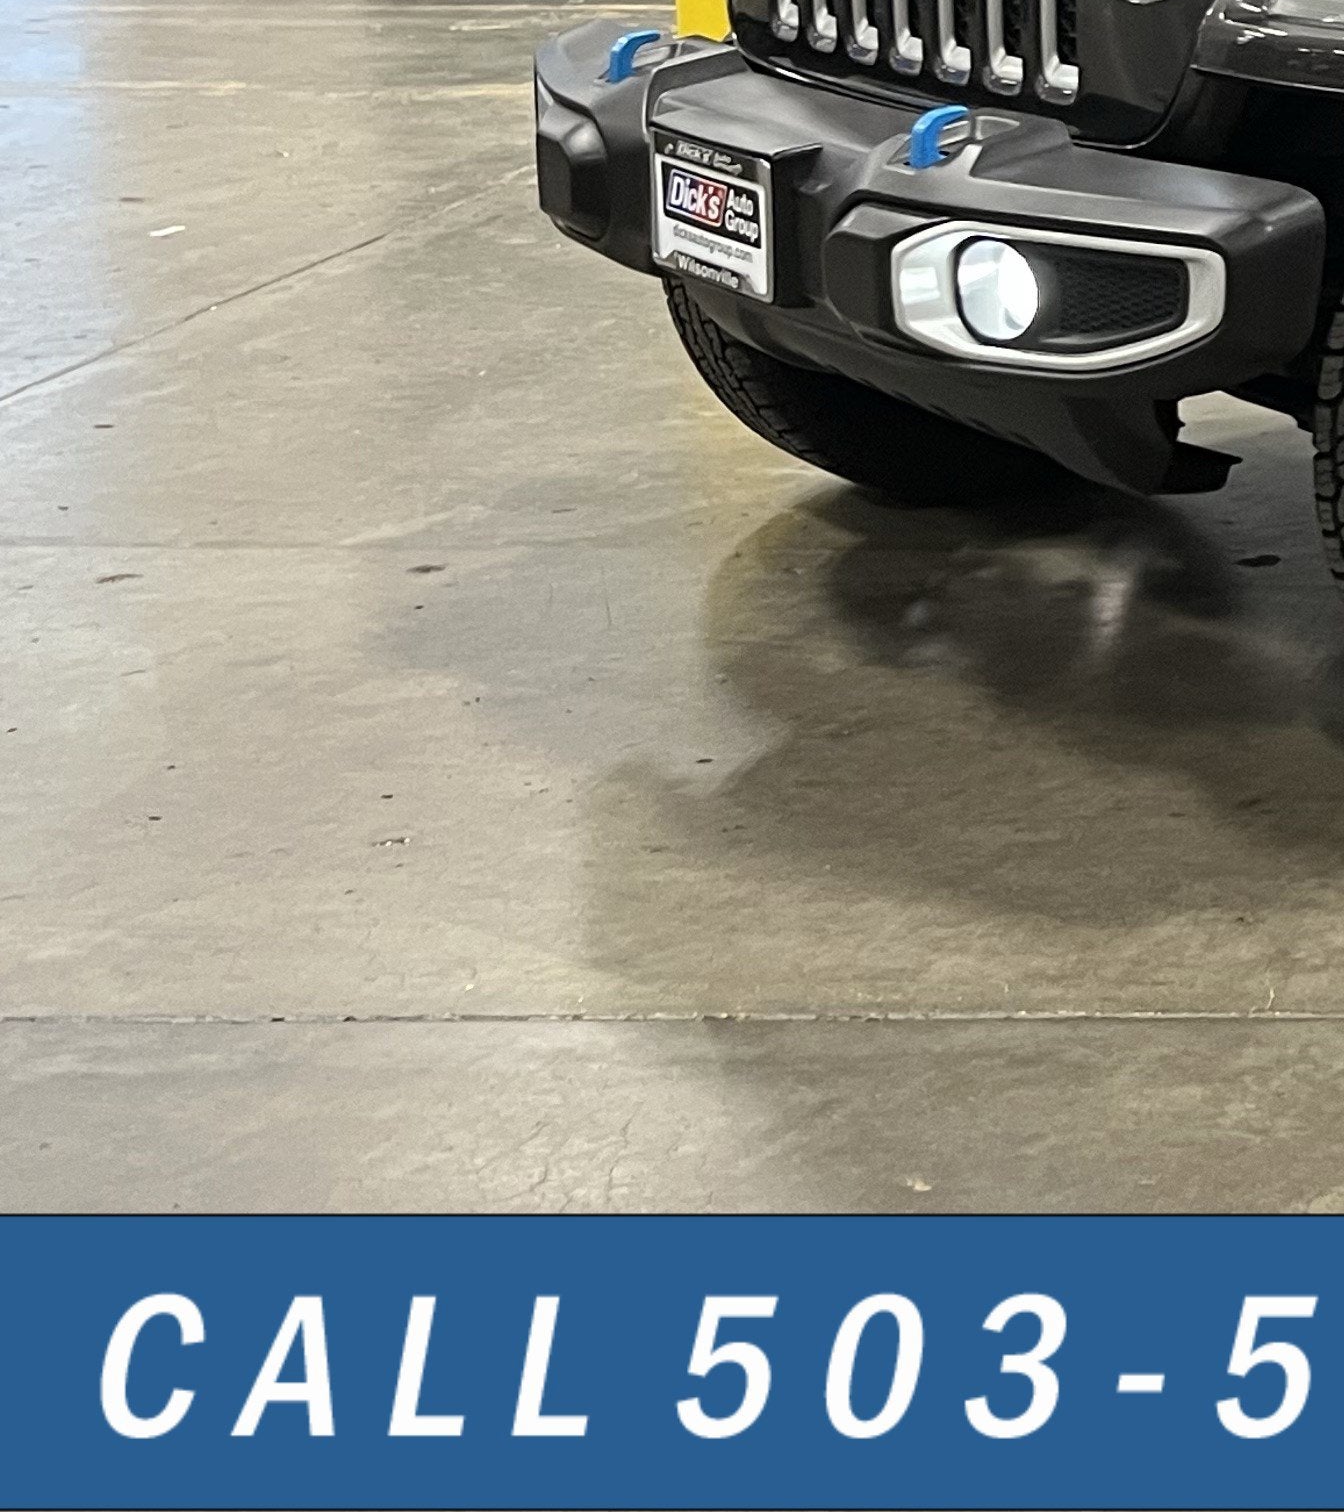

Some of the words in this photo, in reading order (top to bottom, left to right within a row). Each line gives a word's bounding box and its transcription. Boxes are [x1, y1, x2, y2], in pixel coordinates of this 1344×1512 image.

[669, 175, 720, 220] Dick's
[728, 189, 754, 216] Auto
[725, 210, 759, 242] Group
